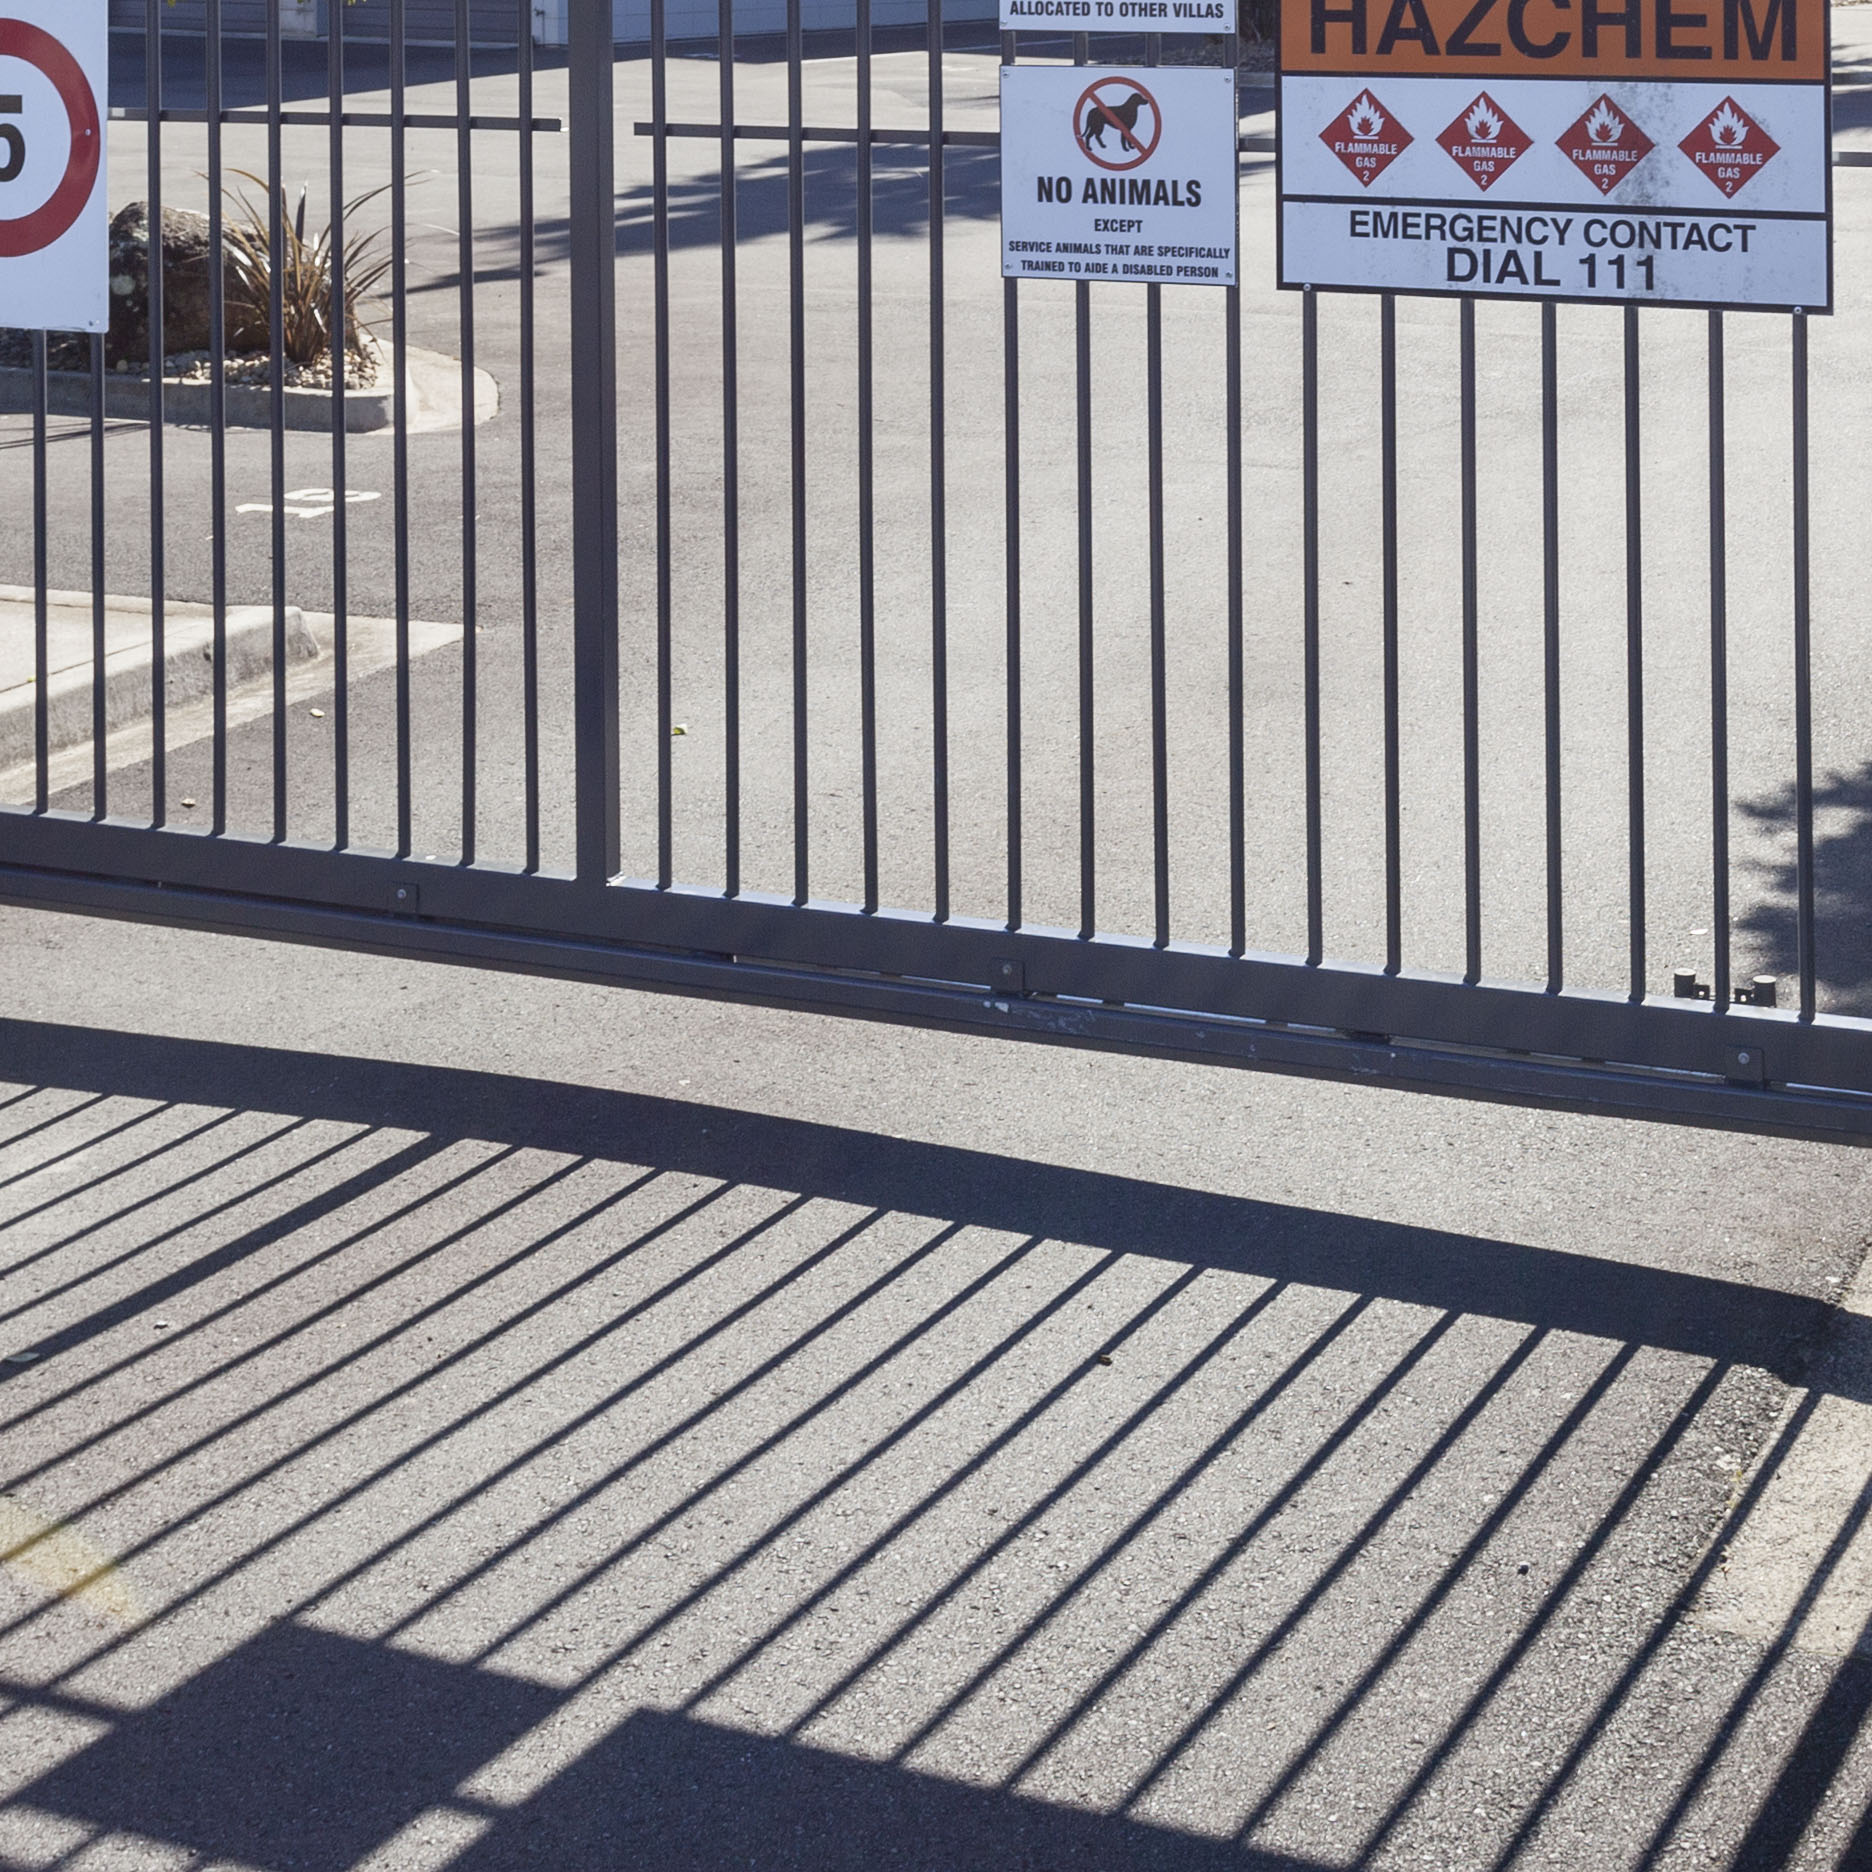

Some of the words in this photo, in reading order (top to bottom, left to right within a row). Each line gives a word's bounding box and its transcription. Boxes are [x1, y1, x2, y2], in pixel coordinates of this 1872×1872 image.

[1010, 1, 1090, 16] ALLOCATED
[1096, 2, 1113, 17] TO
[1119, 2, 1168, 17] OTHER
[1173, 3, 1224, 18] VILLAS
[1335, 142, 1397, 155] FLAMMABLE
[1452, 146, 1517, 158] FLAMMABLE
[1356, 157, 1376, 167] GAS
[1573, 149, 1638, 162] FLAMMABLE
[1696, 152, 1763, 165] FLAMMABLE
[1474, 161, 1494, 172] GAS
[1594, 164, 1616, 175] GAS
[1718, 167, 1740, 179] GAS
[1363, 171, 1369, 181] 2
[1481, 175, 1487, 185] 2
[1602, 178, 1608, 188] 2
[1726, 182, 1732, 192] 2
[1037, 176, 1072, 203] NO
[1082, 178, 1201, 207] ANIMALS
[1095, 219, 1143, 233] EXCEPT
[1349, 210, 1573, 247] EMERGENCY
[1583, 219, 1757, 253] CONTACT
[1009, 241, 1052, 253] SERVICE
[1055, 243, 1101, 254] ANIMALS
[1105, 244, 1130, 256] THAT
[1134, 245, 1154, 257] ARE
[1157, 246, 1230, 259] SPECIFICALLY
[1021, 260, 1065, 272] TRAINED
[1068, 261, 1081, 272] TO
[1085, 262, 1108, 274] AIDE
[1112, 263, 1118, 274] A
[1122, 263, 1173, 276] DISABLED
[1177, 266, 1218, 278] PERSON
[1446, 247, 1560, 287] DIAL
[1578, 253, 1655, 291] 111
